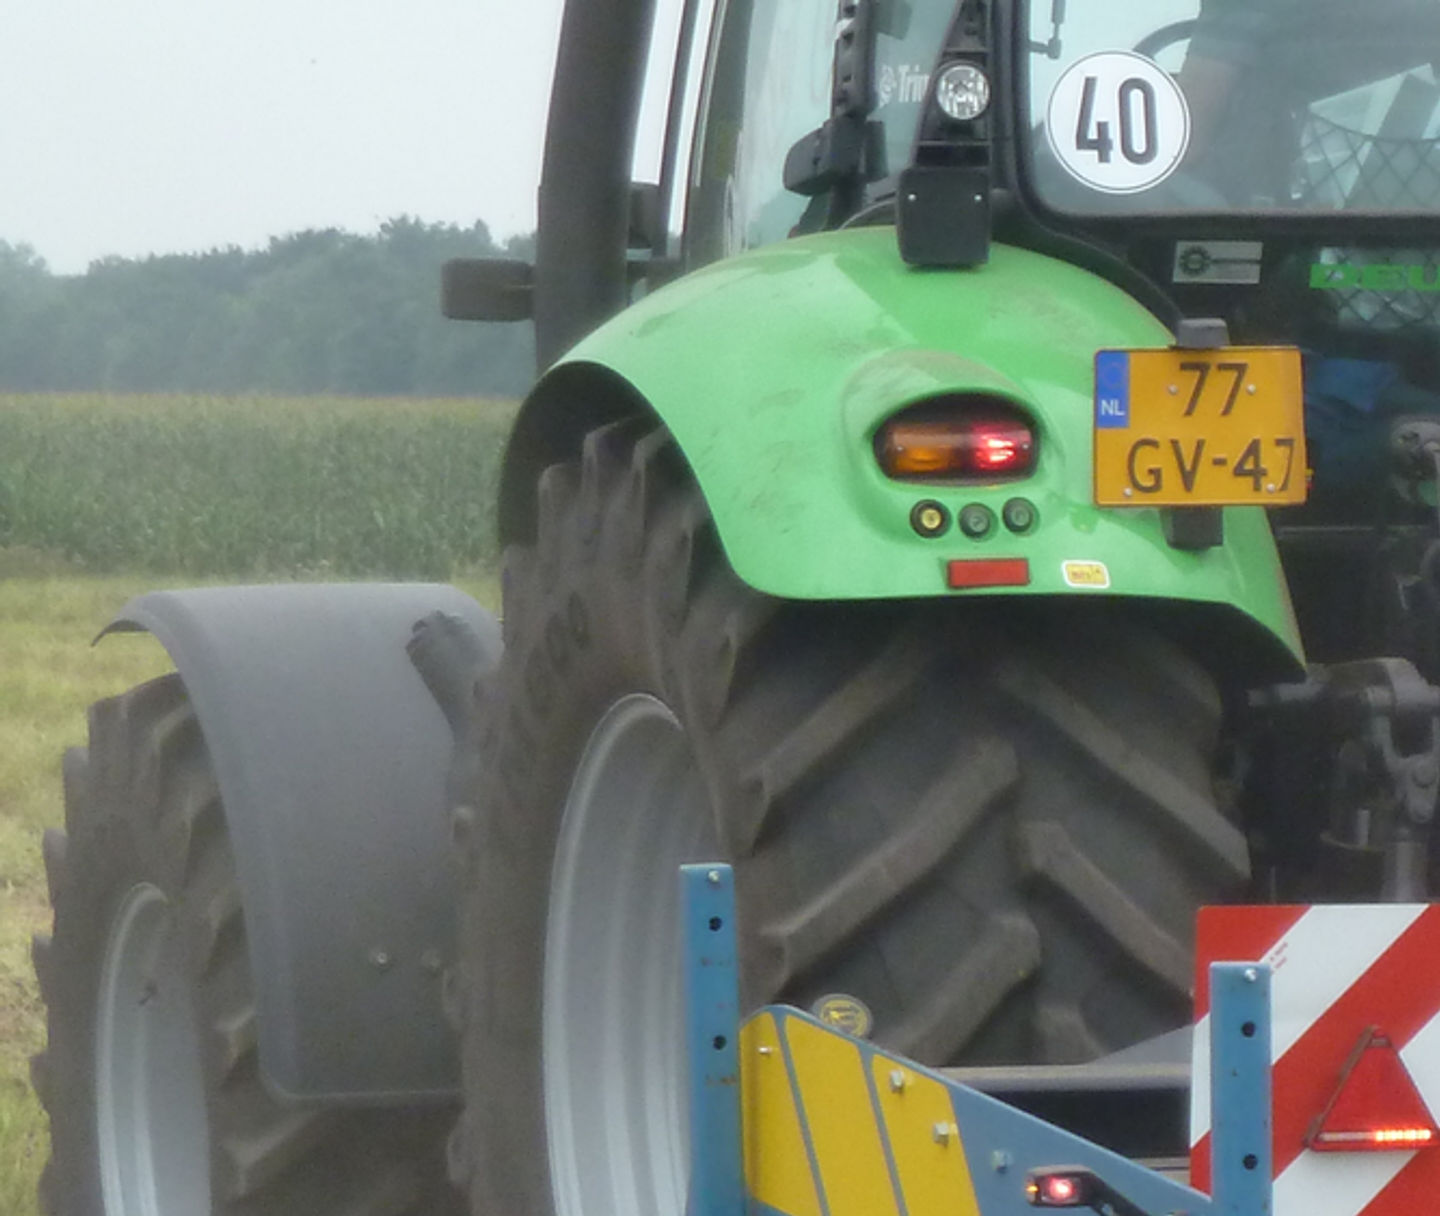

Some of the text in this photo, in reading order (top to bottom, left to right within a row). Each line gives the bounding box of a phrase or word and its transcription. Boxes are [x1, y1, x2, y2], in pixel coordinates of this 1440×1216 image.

[1075, 76, 1159, 165] 40
[1100, 399, 1126, 417] NL
[1179, 362, 1248, 417] 77
[1127, 437, 1296, 493] GV-47
